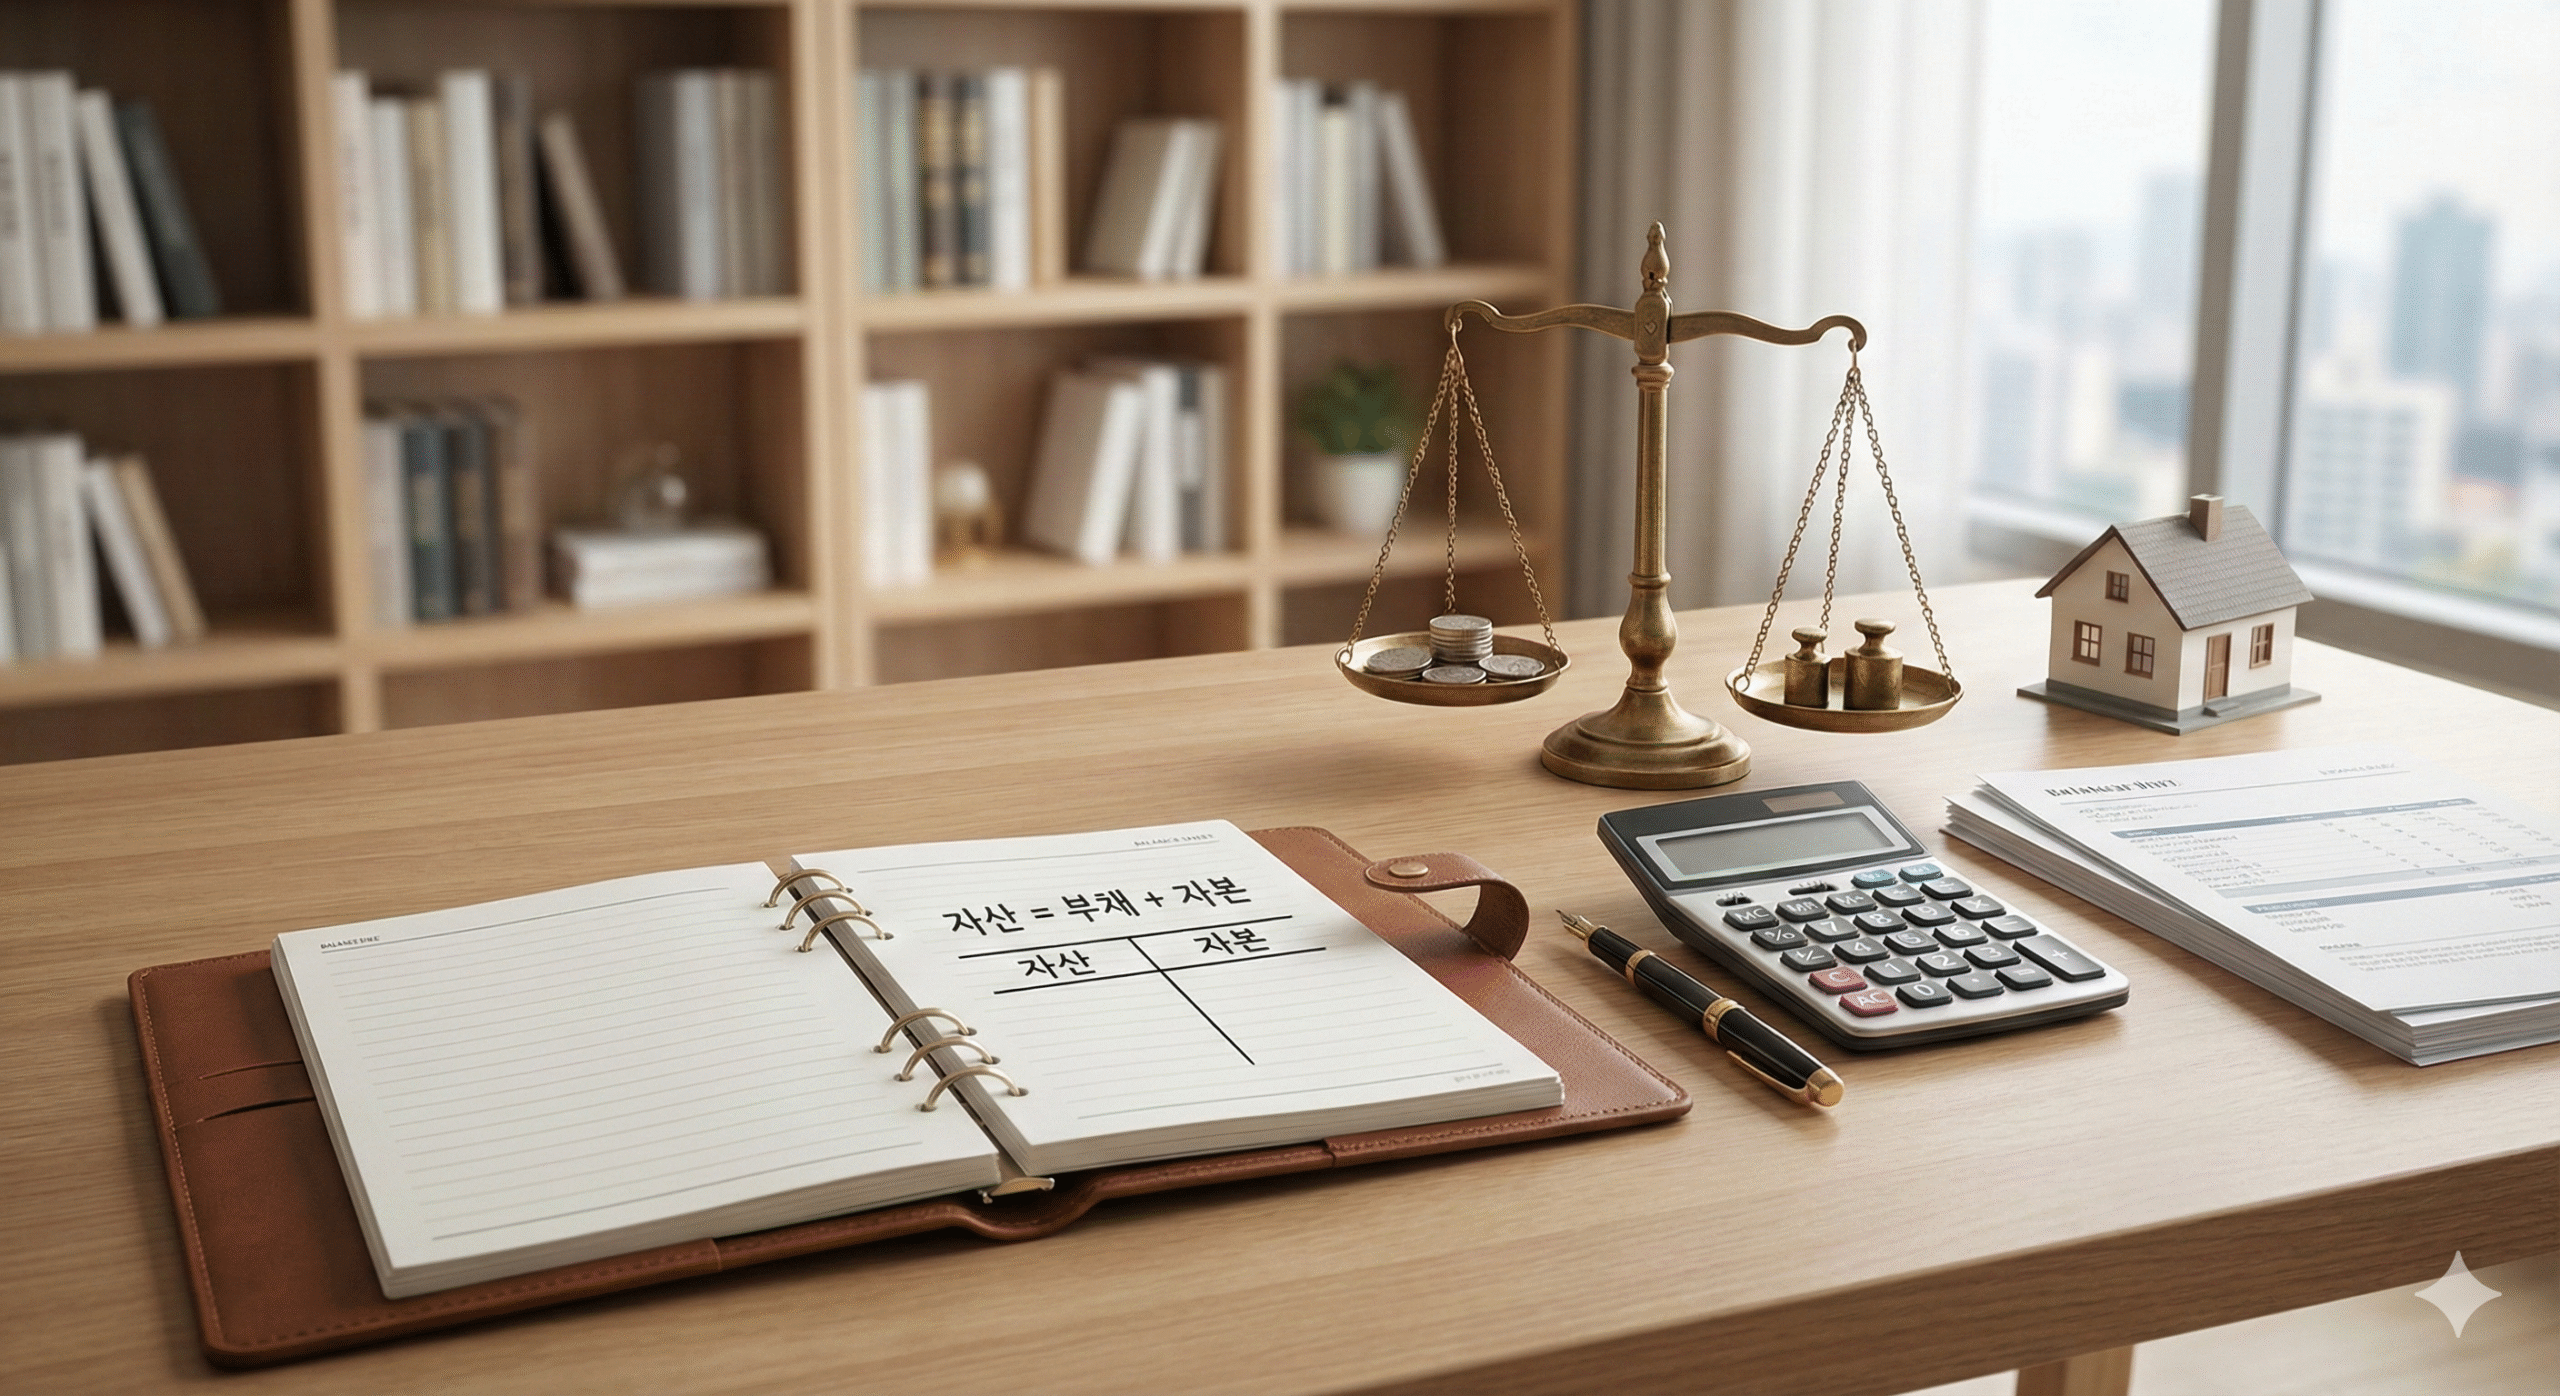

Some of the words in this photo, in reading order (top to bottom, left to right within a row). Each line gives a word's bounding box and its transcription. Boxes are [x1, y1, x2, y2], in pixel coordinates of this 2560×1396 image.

[942, 903, 1025, 936] 자산
[1030, 907, 1055, 920] =
[1061, 889, 1141, 923] 부채
[1144, 891, 1165, 909] +
[1171, 876, 1252, 908] 자본
[1917, 905, 1938, 917] 9
[1734, 908, 1769, 921] MC
[1868, 913, 1892, 924] 8
[1820, 920, 1838, 933] 7
[1950, 925, 1970, 937] 6
[1192, 927, 1270, 955] 자본
[1897, 933, 1922, 945] 5
[1854, 941, 1872, 952] 4
[1980, 946, 2002, 958] 3
[1017, 949, 1096, 979] 자산
[1931, 954, 1957, 967] 2
[1884, 962, 1902, 973] 1
[1828, 971, 1851, 983] C
[1913, 983, 1936, 996] 0
[1856, 992, 1888, 1007] AC
